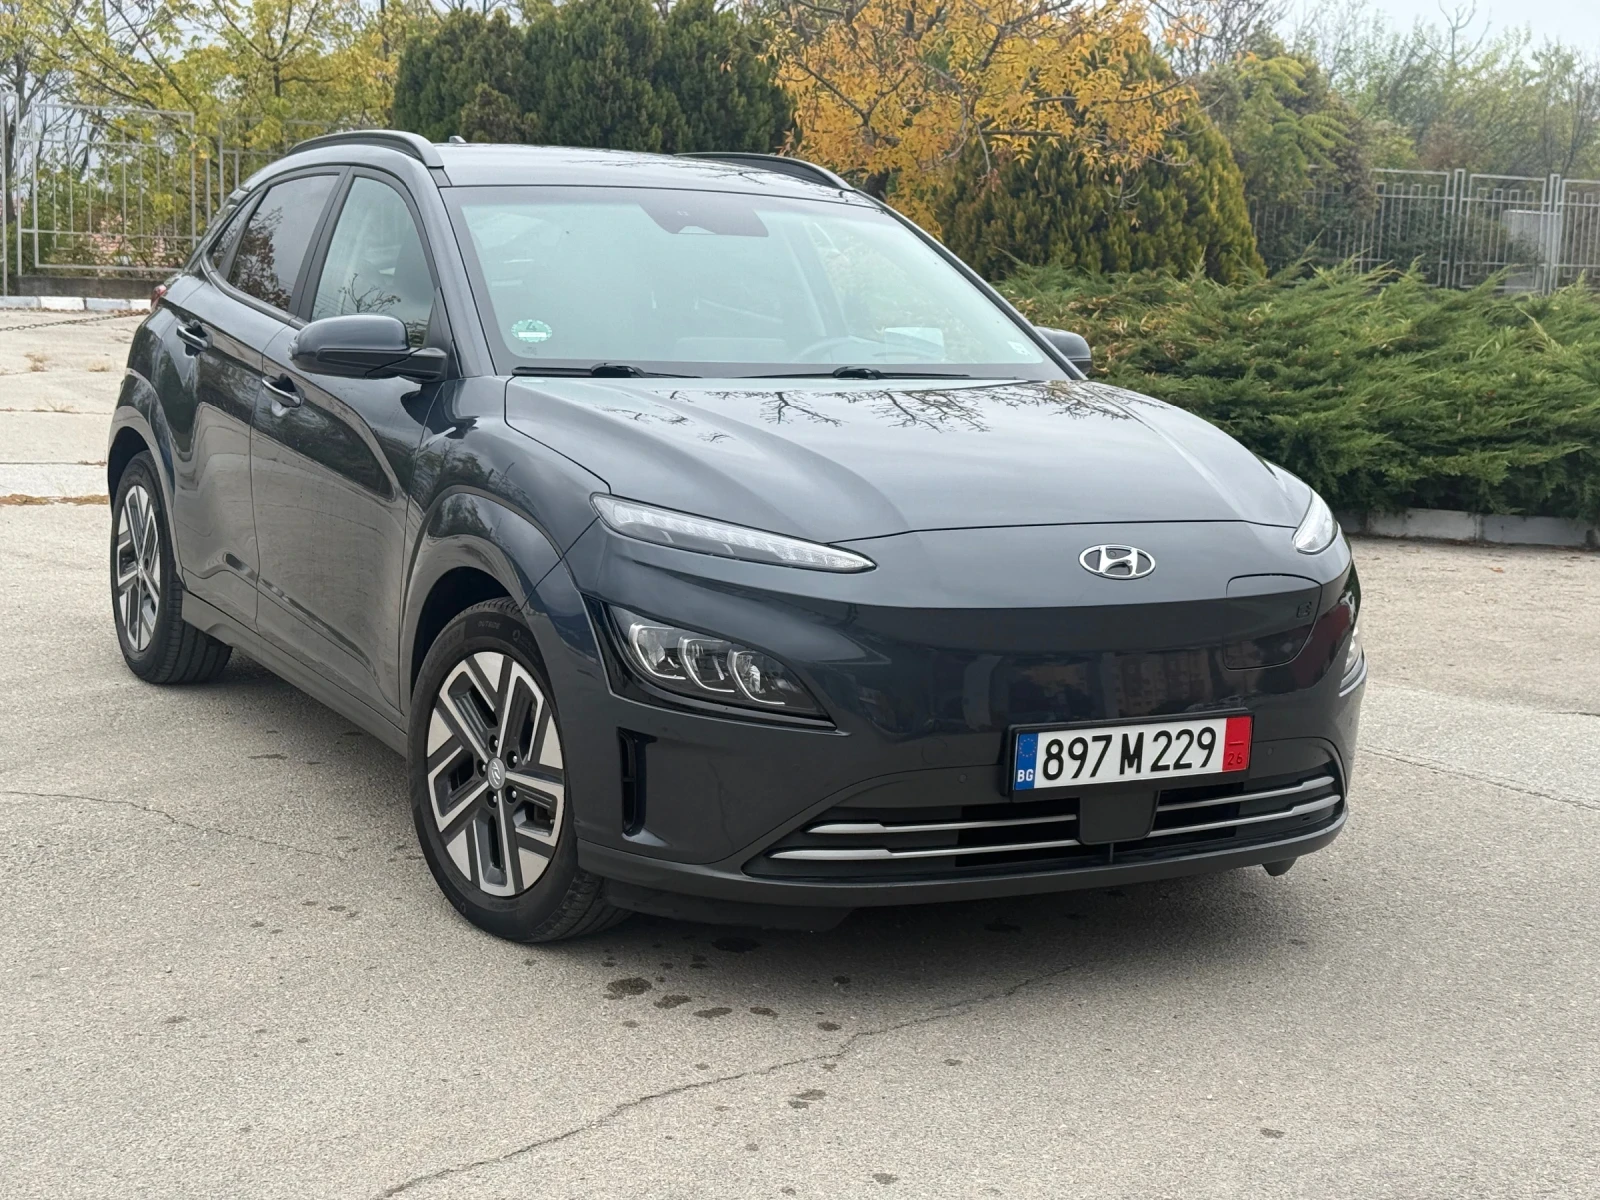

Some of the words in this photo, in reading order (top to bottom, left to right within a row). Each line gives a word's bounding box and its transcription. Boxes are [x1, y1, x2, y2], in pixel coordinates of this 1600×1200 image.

[1042, 735, 1113, 781] 897
[1119, 732, 1145, 775] M
[1150, 727, 1217, 772] 229
[1227, 751, 1243, 766] 26
[1017, 768, 1034, 783] BG
